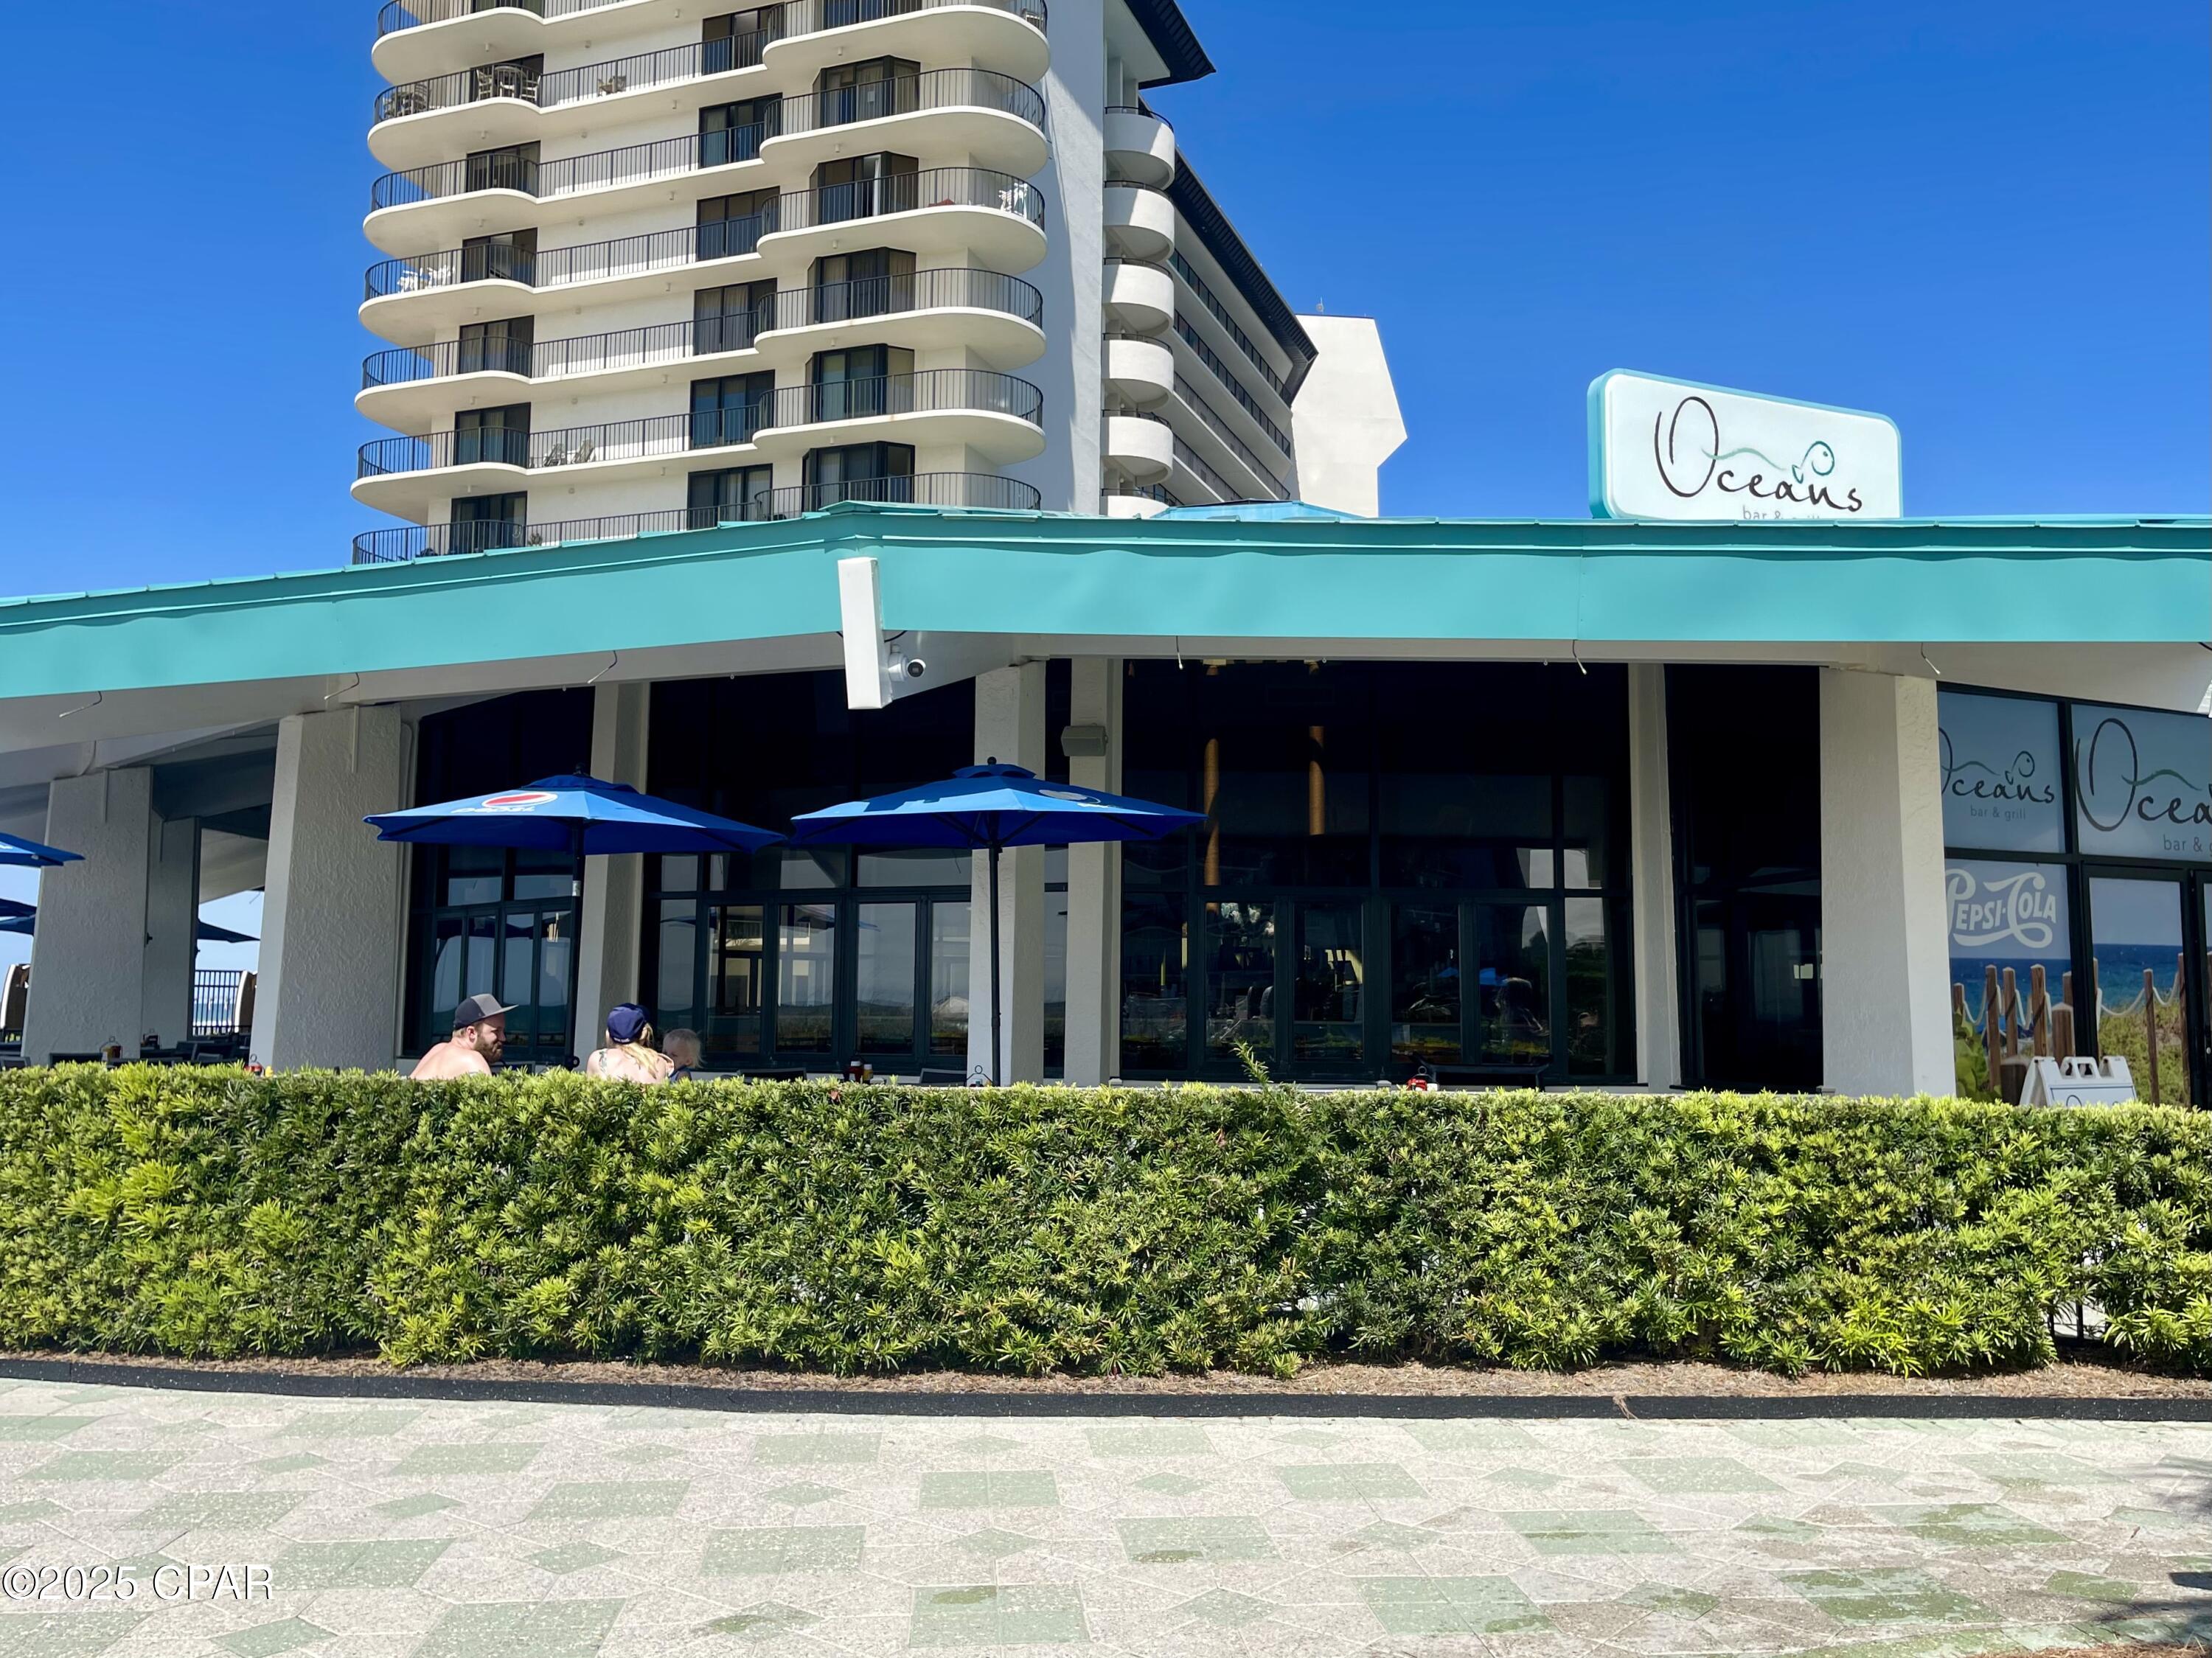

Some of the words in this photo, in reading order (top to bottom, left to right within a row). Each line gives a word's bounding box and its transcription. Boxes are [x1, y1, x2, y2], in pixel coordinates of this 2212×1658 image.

[1655, 397, 1863, 511] Oceans
[1742, 504, 1767, 520] bar
[2075, 718, 2212, 832] Ocea
[1970, 804, 1987, 817] bar
[1992, 807, 2000, 818] &
[2005, 808, 2026, 821] grill
[2163, 834, 2186, 851] bar
[2194, 837, 2202, 852] &
